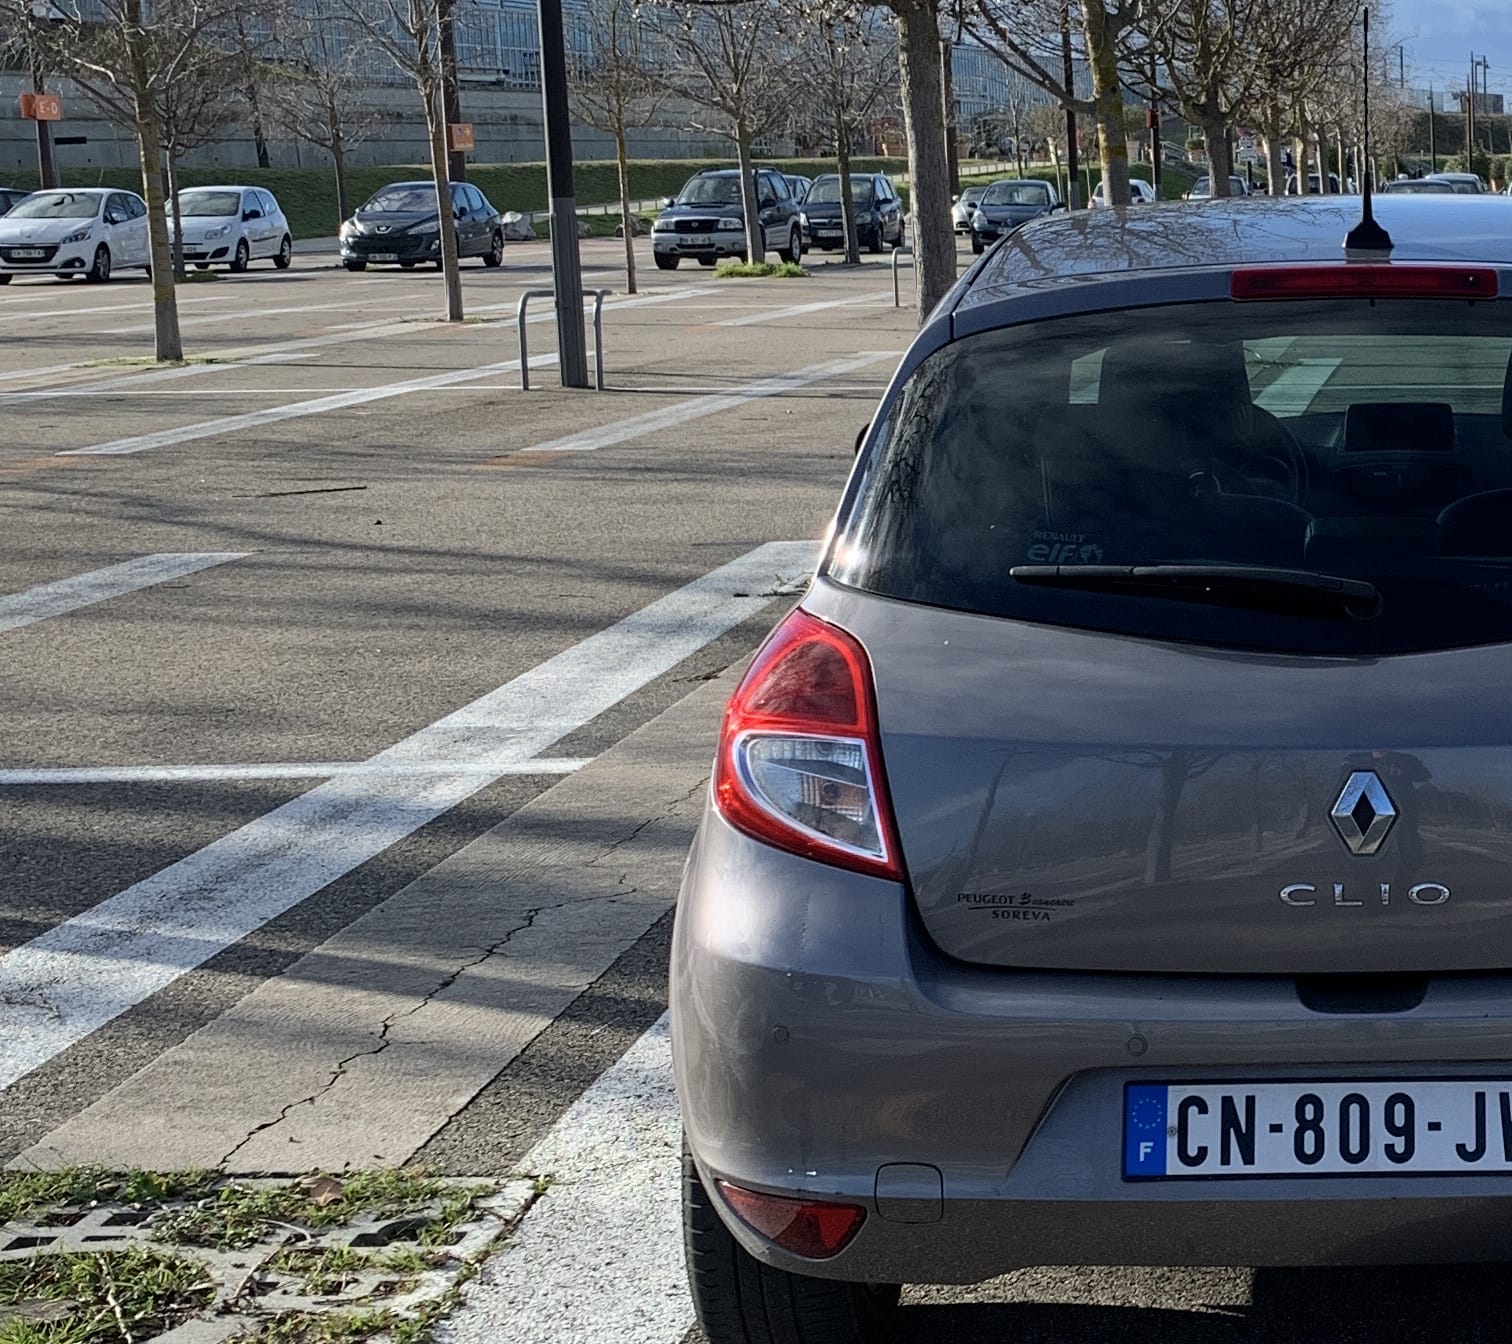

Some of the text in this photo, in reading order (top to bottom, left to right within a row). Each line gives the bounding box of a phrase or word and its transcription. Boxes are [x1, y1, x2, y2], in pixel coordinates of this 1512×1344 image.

[1033, 530, 1085, 543] RENAULT
[957, 893, 1014, 905] PEUGEOT
[1279, 882, 1451, 906] CLIO
[991, 909, 1051, 921] SOREVA
[1139, 1141, 1155, 1162] F
